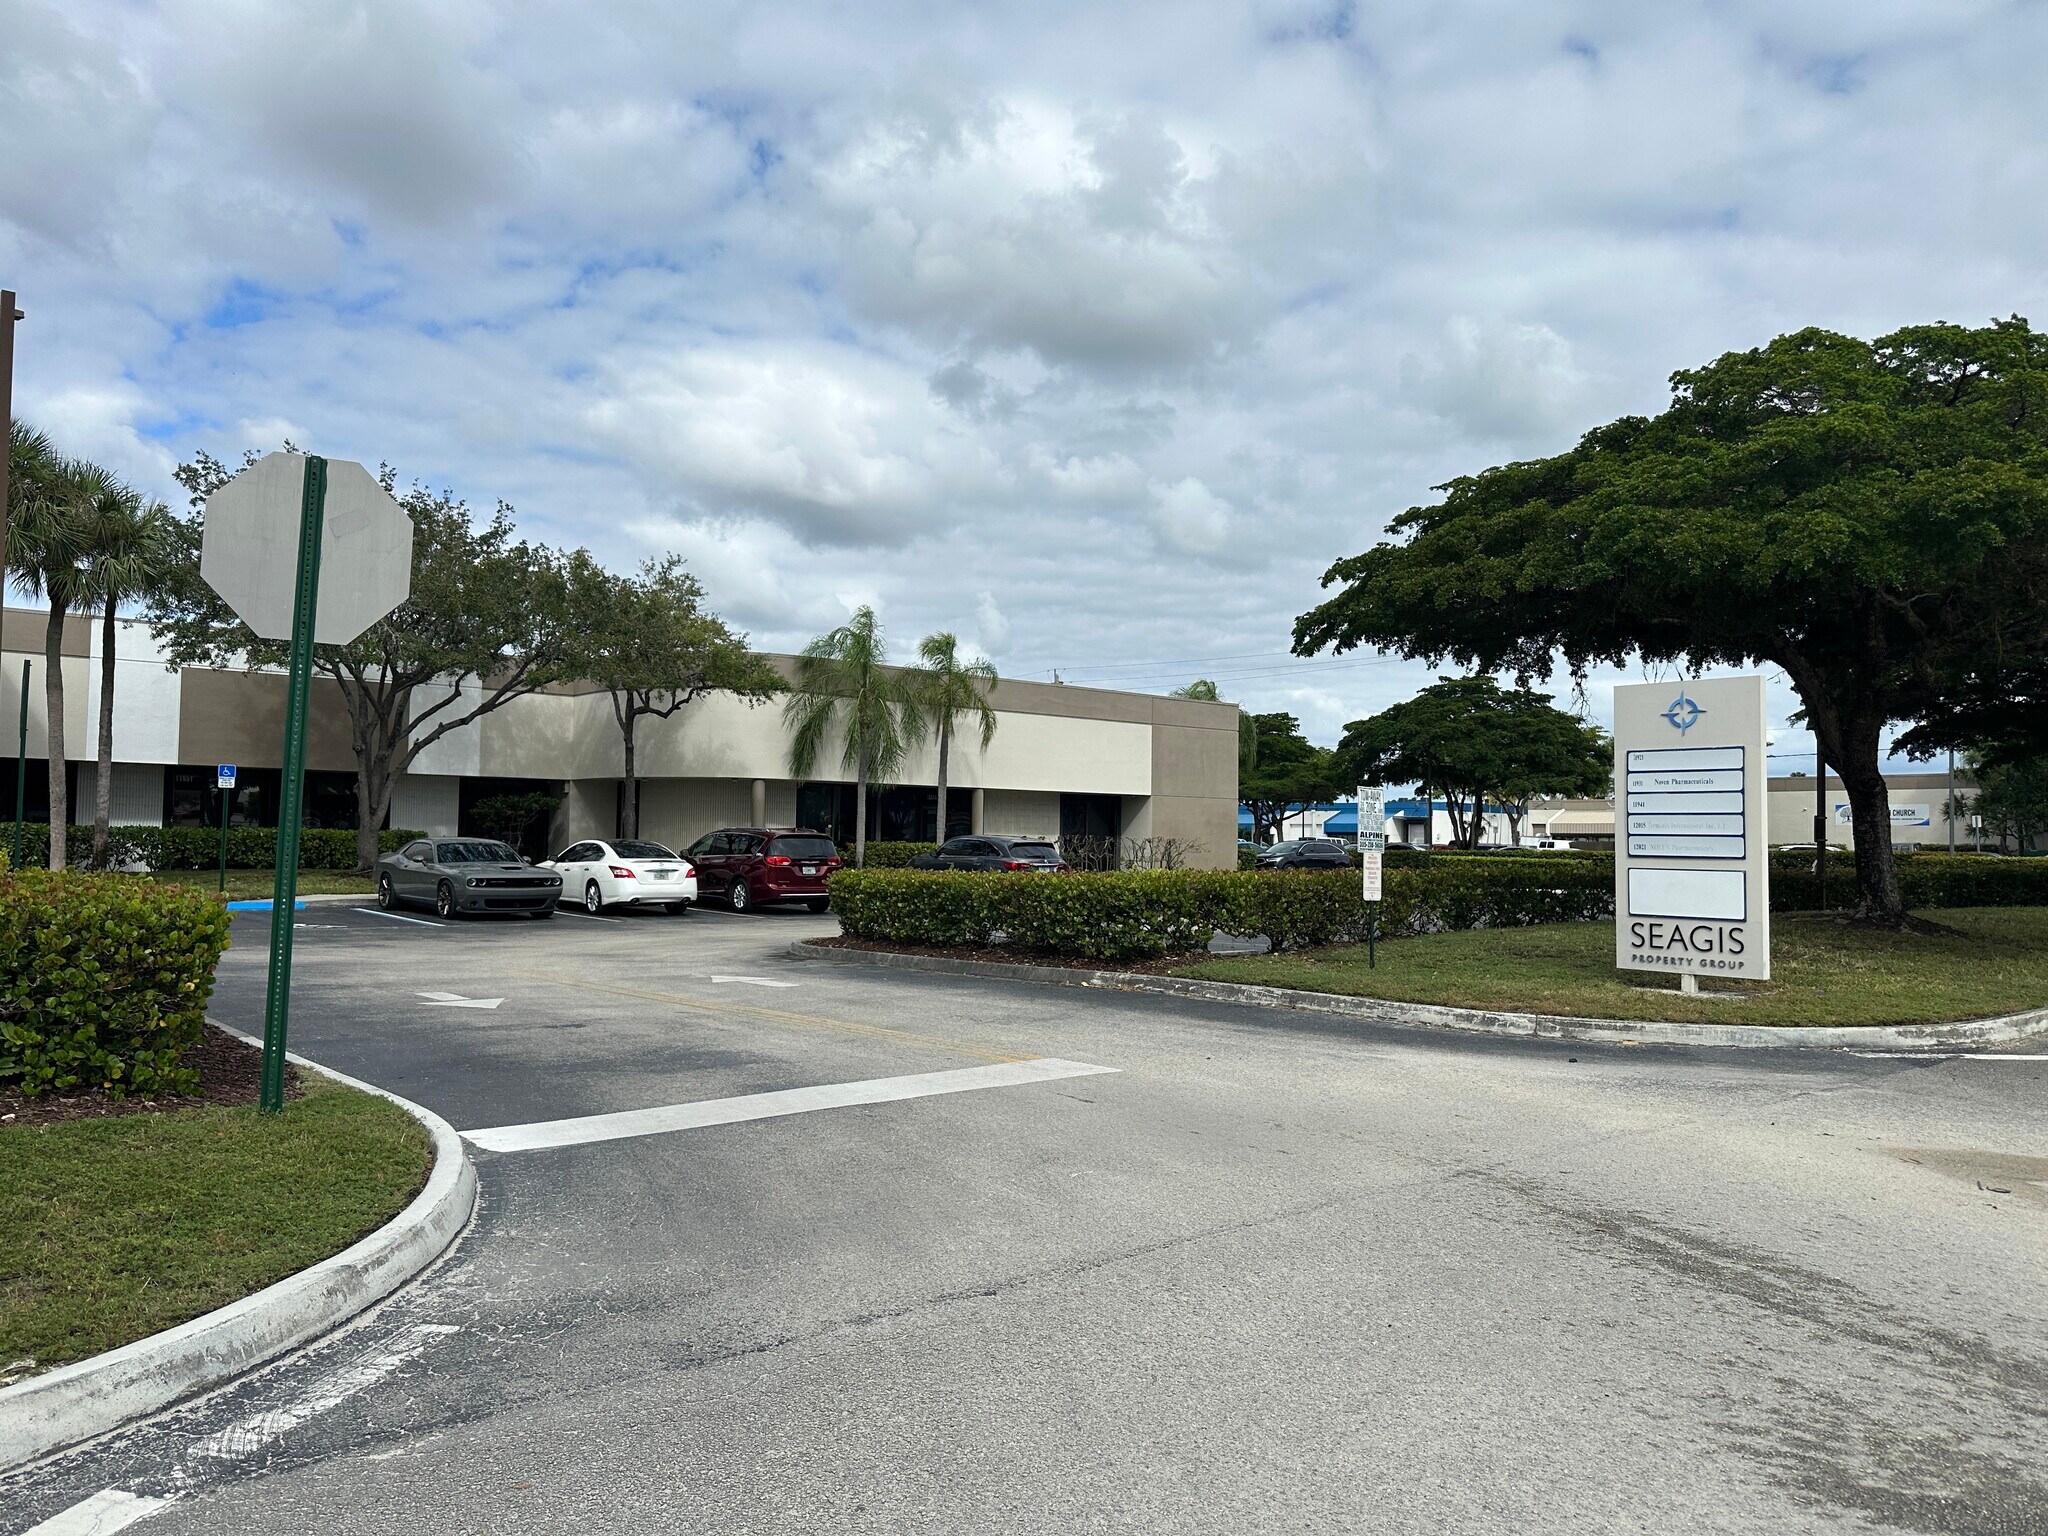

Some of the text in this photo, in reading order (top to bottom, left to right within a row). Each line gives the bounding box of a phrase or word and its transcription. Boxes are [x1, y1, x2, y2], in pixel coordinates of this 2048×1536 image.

[1360, 831, 1383, 839] ALPINE
[1631, 922, 1745, 955] SEAGIS
[1632, 954, 1745, 970] PROPERTY GROUP
